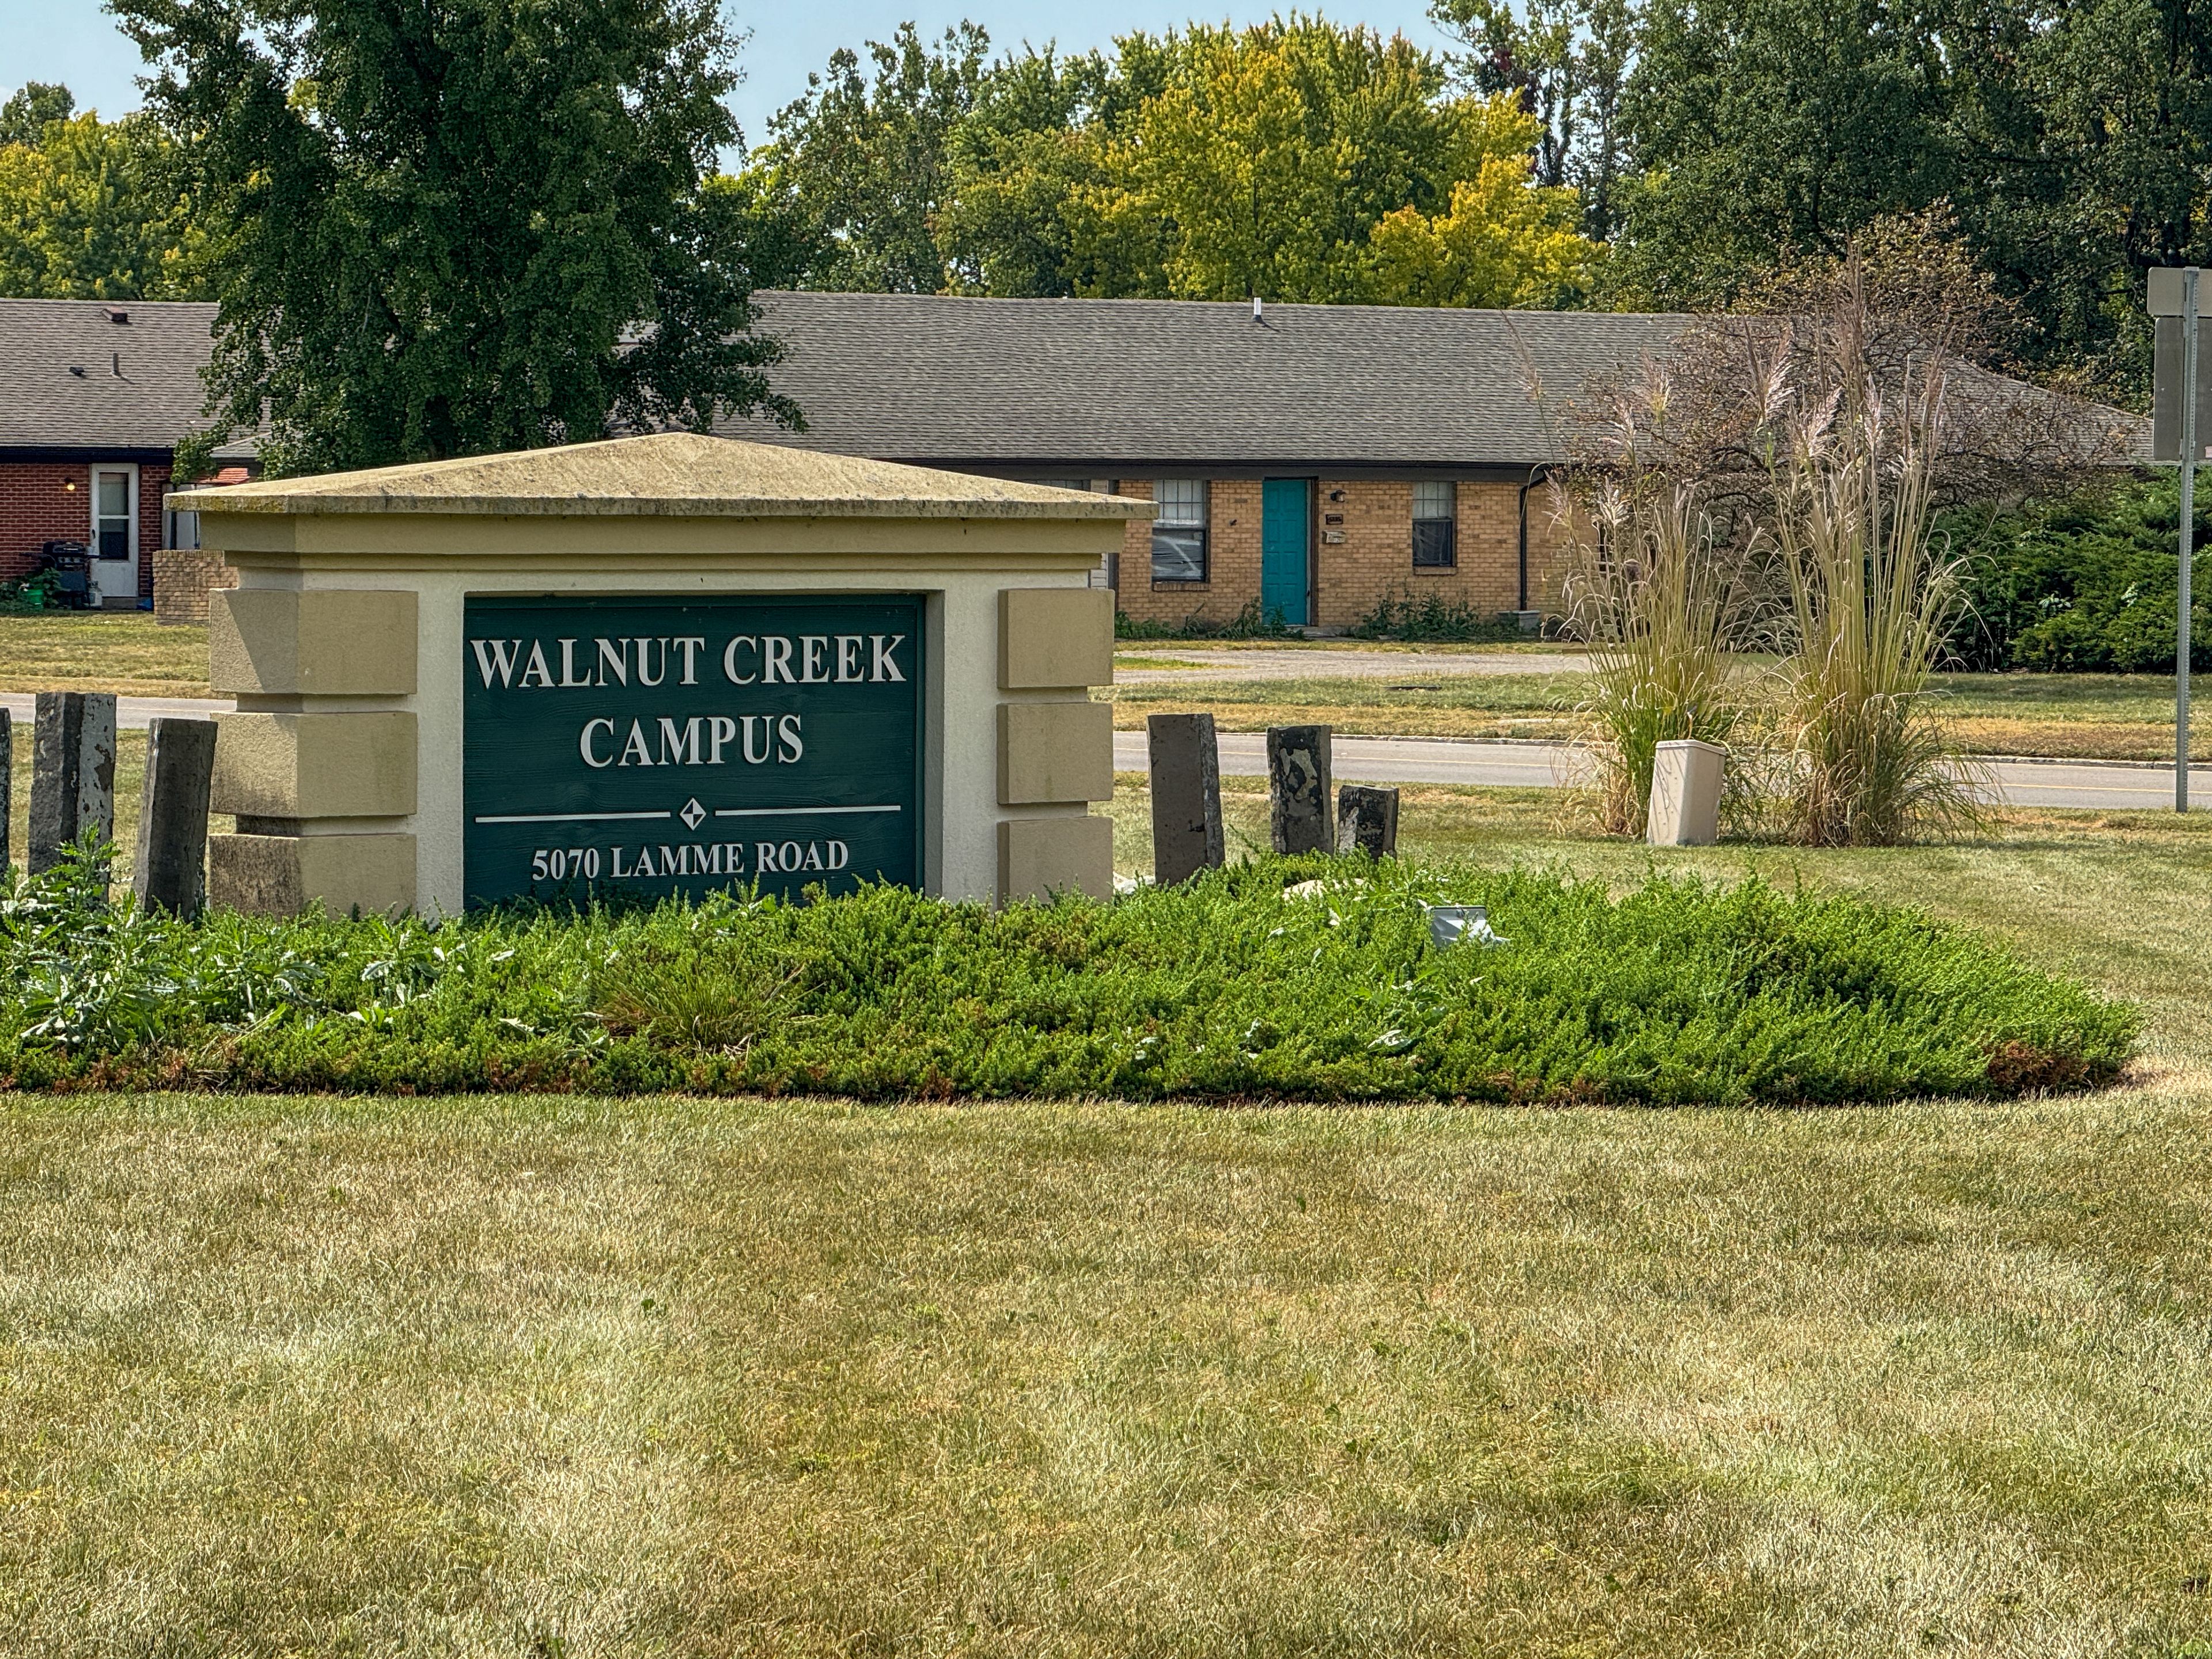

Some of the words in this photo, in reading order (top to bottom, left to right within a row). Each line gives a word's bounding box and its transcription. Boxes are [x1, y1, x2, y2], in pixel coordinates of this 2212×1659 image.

[470, 638, 704, 689] WALNUT
[724, 635, 907, 684] CREEK
[580, 714, 803, 767] CAMPUS
[532, 848, 600, 880] 5070
[611, 843, 744, 877] LAMME
[755, 840, 849, 873] ROAD
